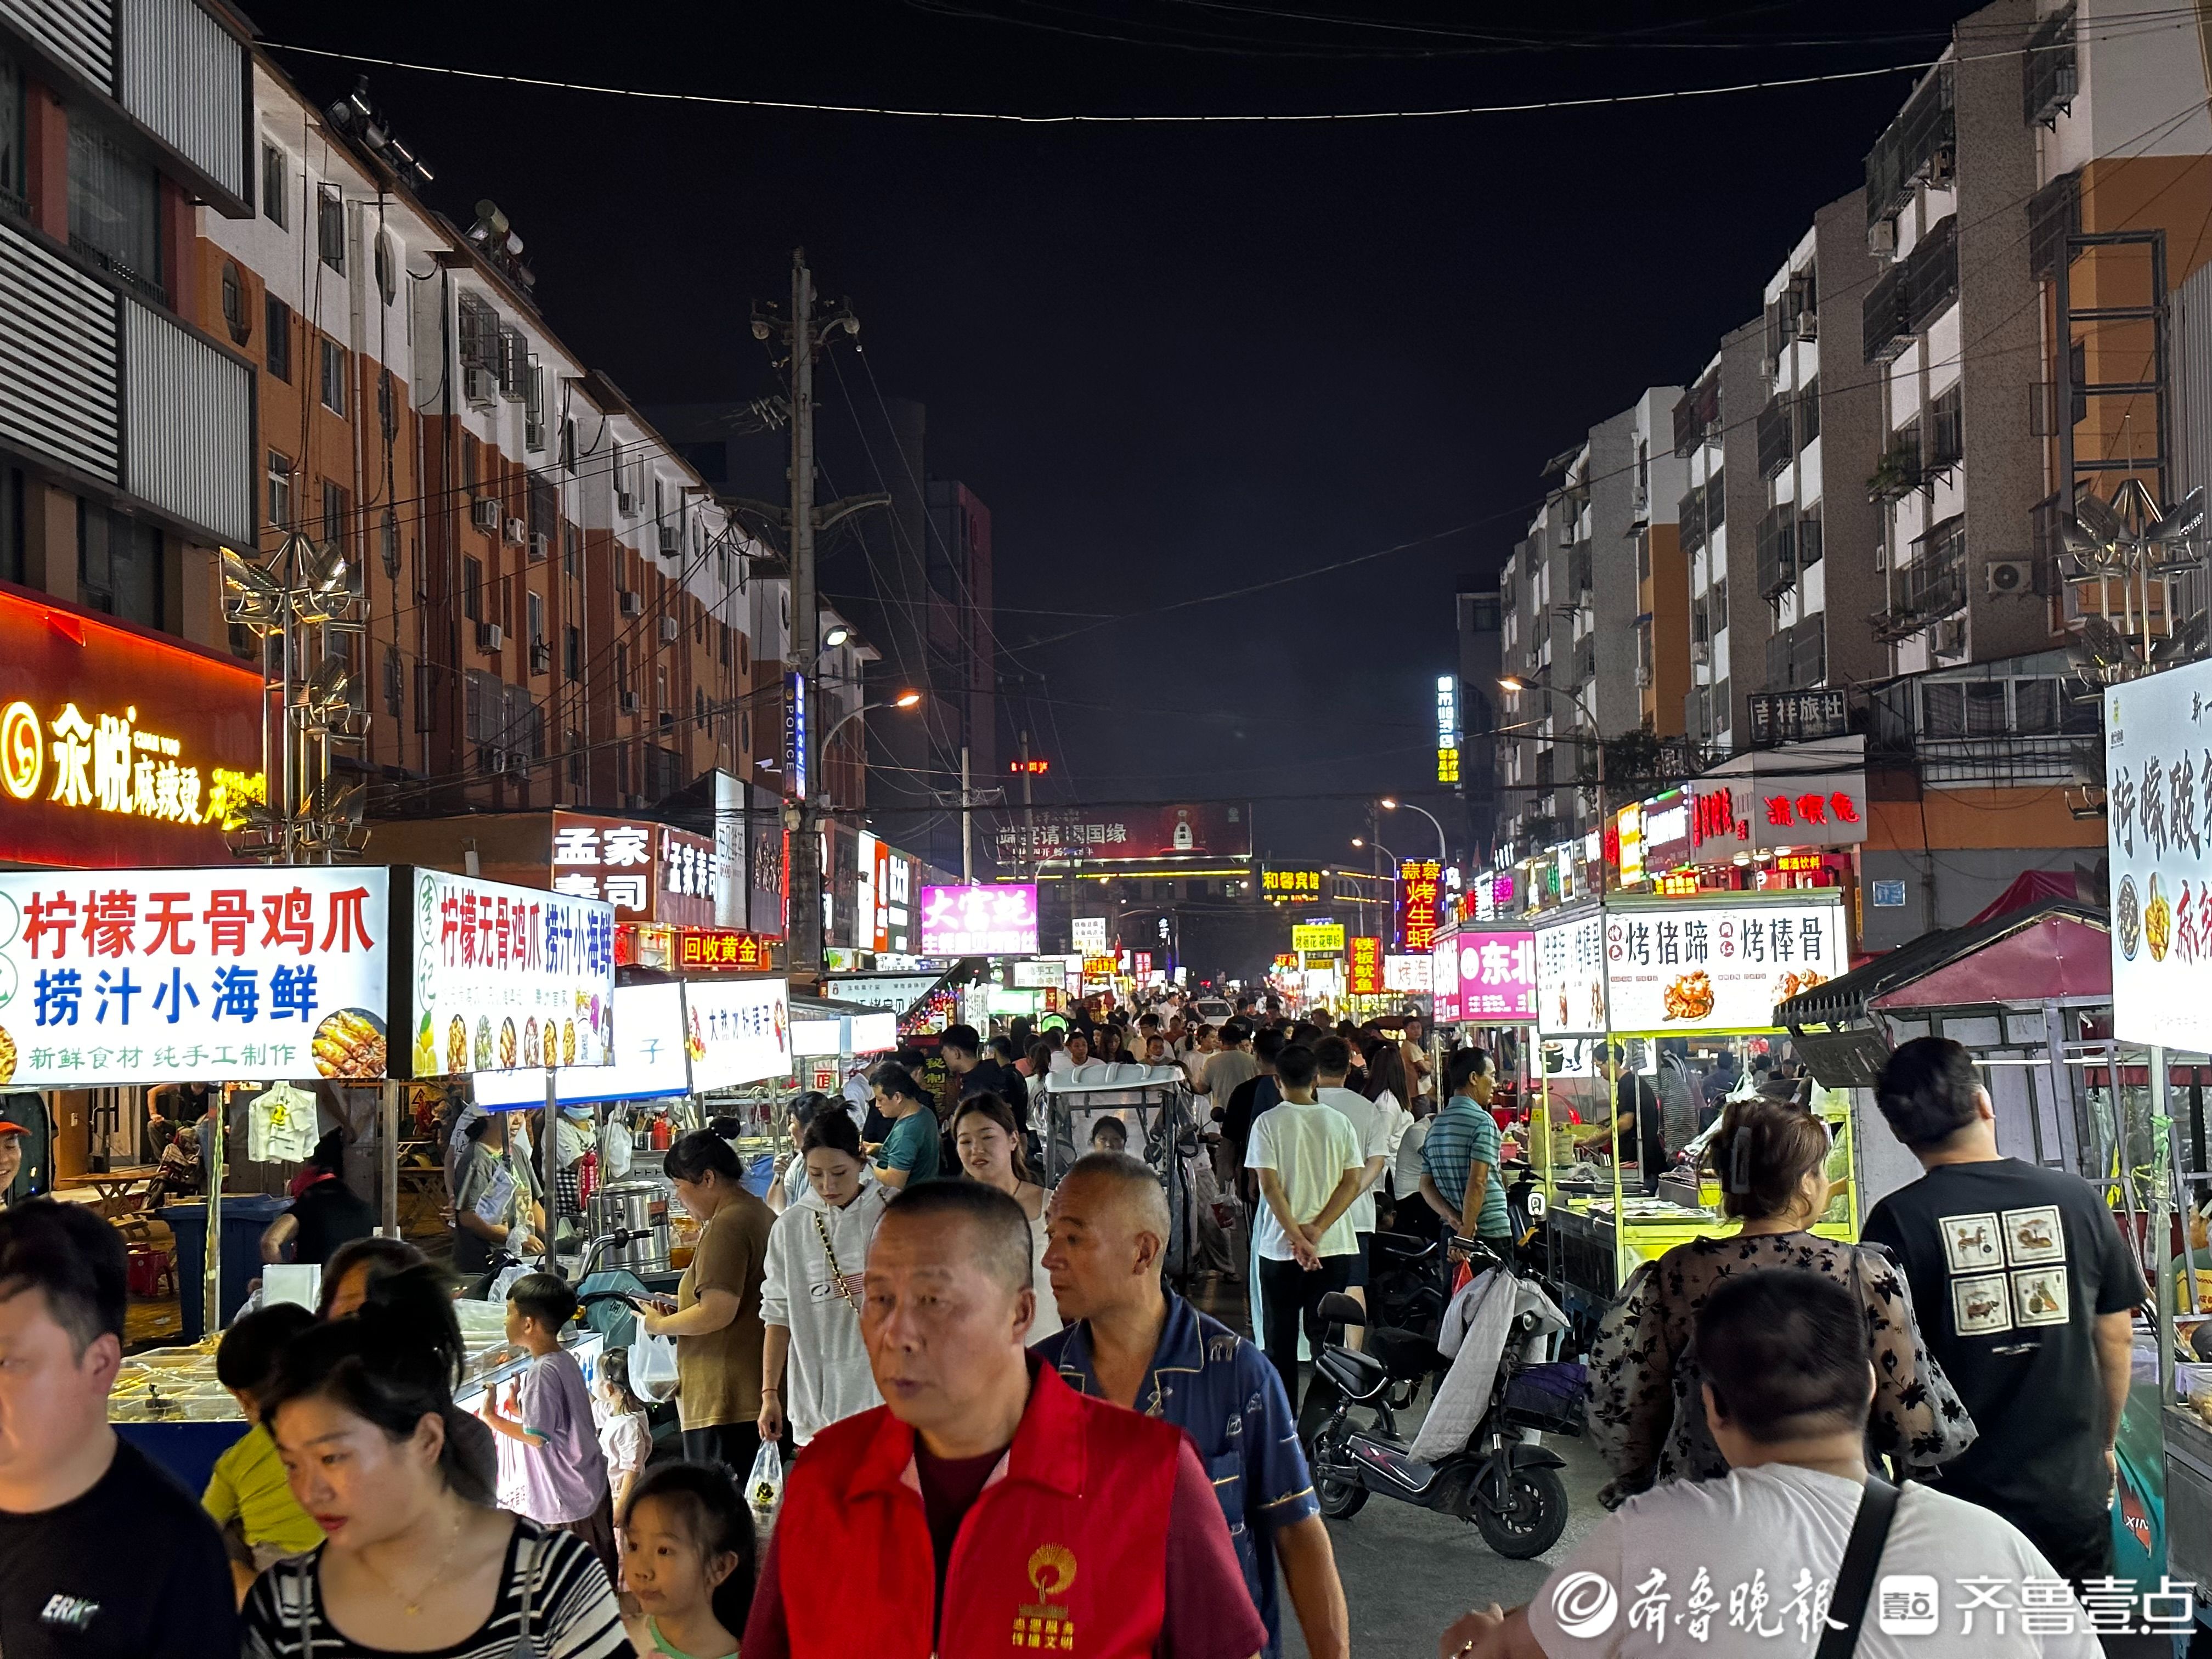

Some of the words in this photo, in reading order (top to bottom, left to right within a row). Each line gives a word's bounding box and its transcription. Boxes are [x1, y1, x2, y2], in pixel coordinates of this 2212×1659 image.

[1755, 695, 1843, 725] 吉祥旅社
[786, 705, 794, 770] POLICE
[553, 826, 650, 866] 孟家
[1778, 856, 1821, 871] 烟酒饮料
[553, 873, 647, 912] 寿司
[668, 841, 716, 901] 孟家寿司
[22, 886, 375, 960] 柠檬无骨鸡爪
[441, 885, 541, 972] 柠檬无骨鸡爪
[545, 903, 611, 979] 捞汁小海鲜
[1626, 920, 1708, 966] 烤猪蹄
[1741, 917, 1822, 963] 烤棒骨
[685, 935, 758, 962] 回收黄金
[1354, 937, 1375, 991] 铁板鱿鱼
[1480, 940, 1536, 985] 东北
[34, 963, 318, 1027] 捞汁小海鲜
[29, 1045, 143, 1070] 新鲜食材
[153, 1043, 297, 1069] 纯手工制作
